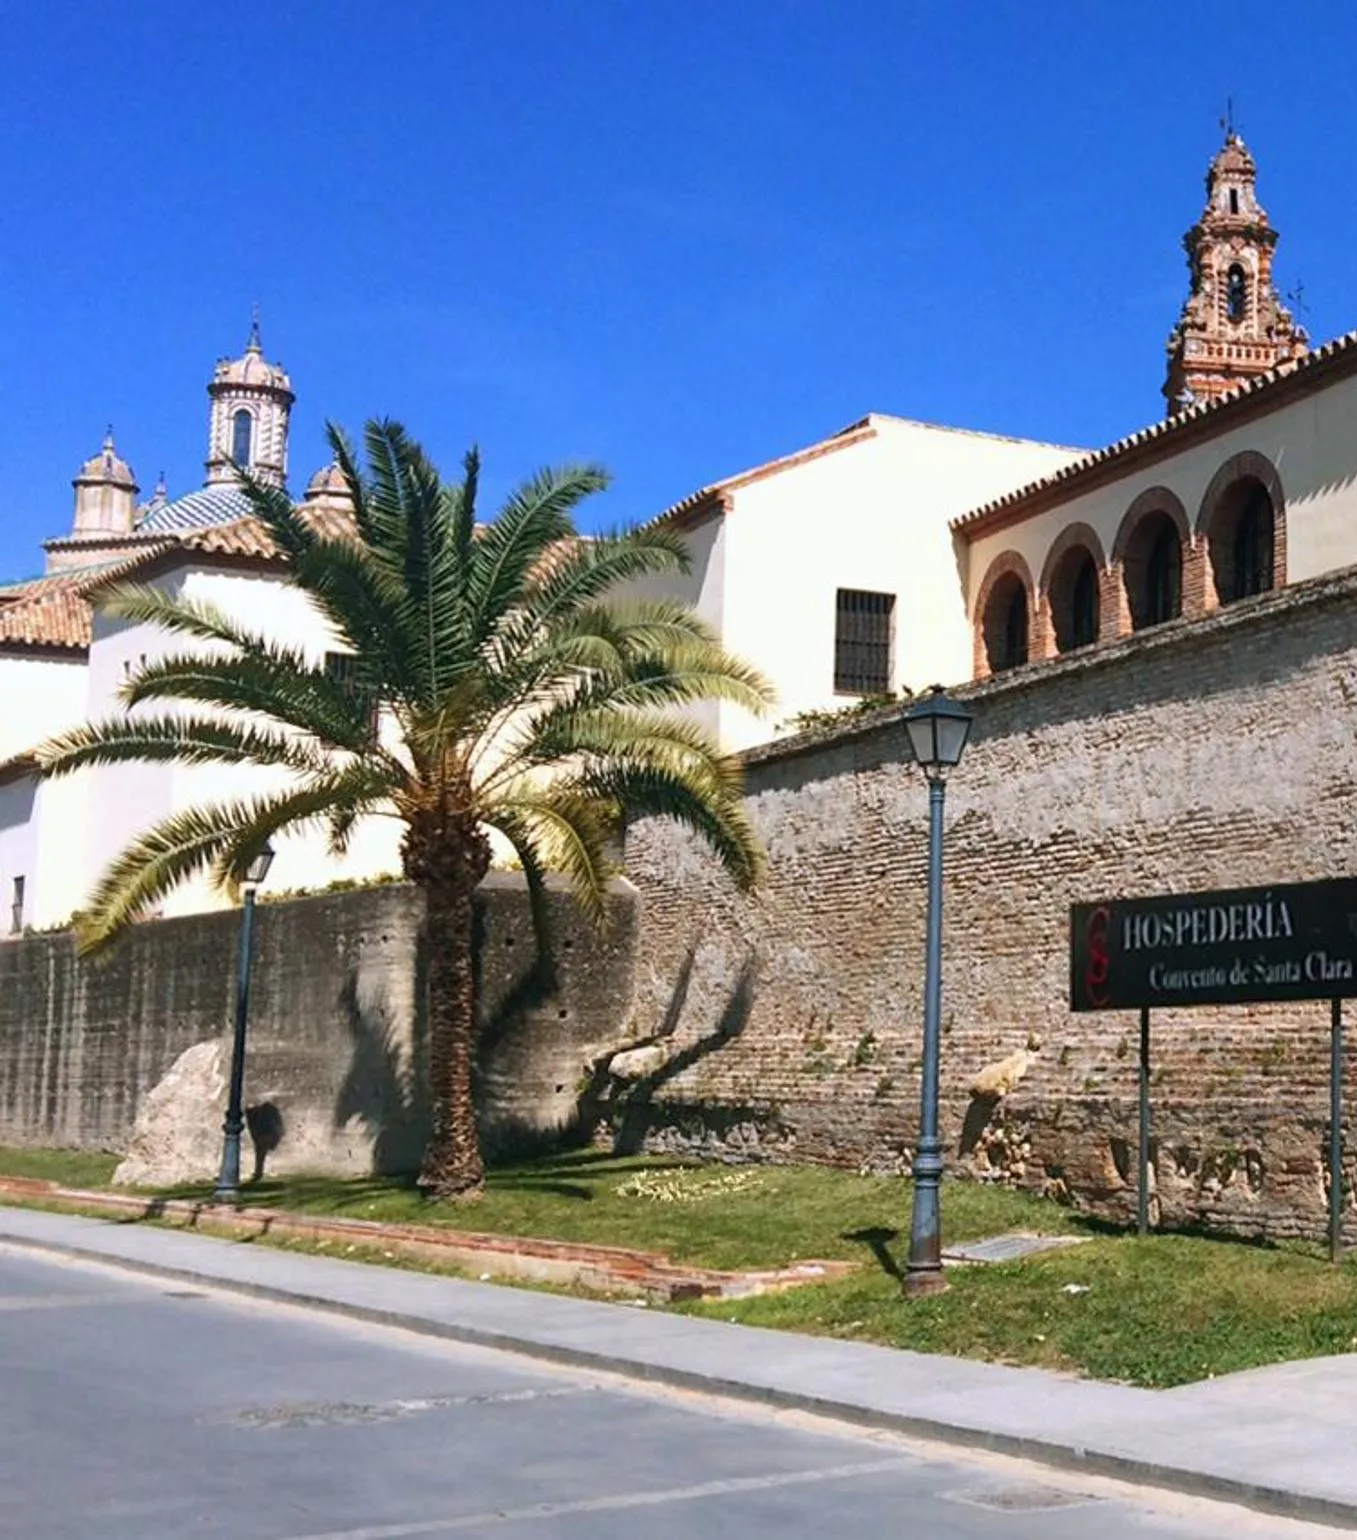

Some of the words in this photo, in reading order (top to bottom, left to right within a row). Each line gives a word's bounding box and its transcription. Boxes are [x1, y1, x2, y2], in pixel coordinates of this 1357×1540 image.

[1122, 892, 1293, 950] HOSPEDERÍA
[1149, 962, 1226, 990] Convento
[1229, 959, 1249, 985] de
[1252, 956, 1300, 984] Santa
[1304, 951, 1353, 981] Clara
